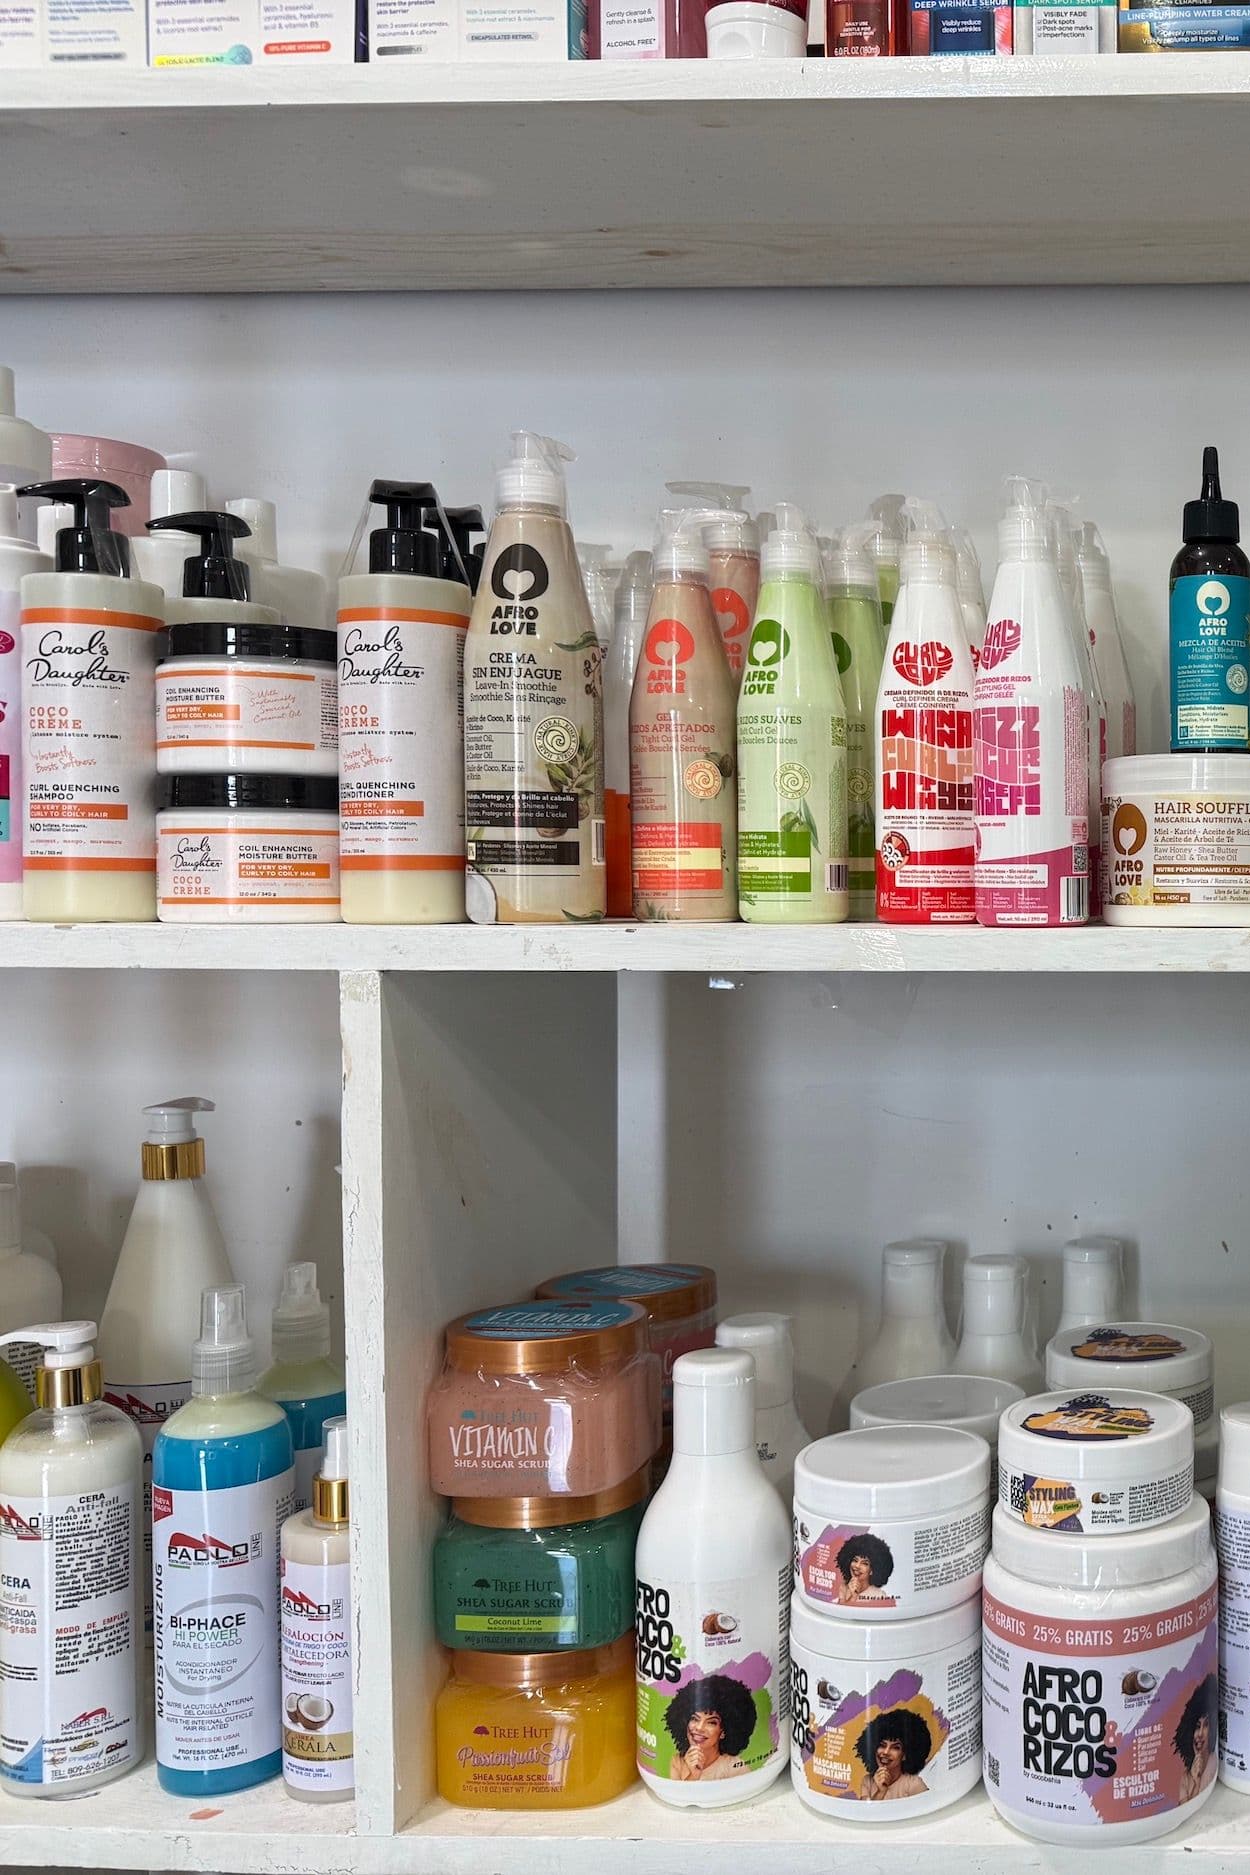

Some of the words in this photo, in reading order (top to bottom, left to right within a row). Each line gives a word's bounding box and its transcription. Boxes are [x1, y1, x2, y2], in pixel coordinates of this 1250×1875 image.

[941, 0, 977, 8] WRINKLE
[491, 605, 539, 621] AFRO
[490, 620, 537, 636] LOVE
[1198, 617, 1228, 627] AFRO
[1199, 627, 1227, 637] LOVE
[38, 630, 109, 657] Carol's
[344, 625, 404, 656] Carol's
[1179, 639, 1206, 649] MEZCLA
[1208, 639, 1219, 647] DE
[489, 652, 537, 665] CREMA
[26, 656, 128, 687] Daughter
[339, 652, 422, 685] Daughter
[472, 667, 489, 679] SIN
[744, 670, 778, 683] AFRO
[743, 683, 775, 696] LOVE
[29, 706, 69, 718] COCO
[30, 784, 50, 793] CURL
[52, 784, 120, 794] QUENCHING
[30, 793, 74, 801] SHAMPOO
[1154, 802, 1191, 816] HAIR
[1154, 816, 1201, 824] MASCARILLA
[1202, 816, 1243, 825] NUTRITIVA
[177, 836, 211, 854] Carol's
[238, 845, 259, 853] COIL
[262, 845, 313, 853] ENHANCING
[170, 853, 222, 871] Daughter
[239, 852, 283, 860] MOISTURE
[286, 853, 318, 861] BUTTER
[1114, 859, 1144, 873] AFRO
[1115, 873, 1142, 887] LOVE
[449, 1425, 538, 1460] VITAMIN
[454, 1459, 478, 1469] SHEA
[481, 1460, 515, 1469] SUGAR
[79, 1493, 106, 1506] CERA
[1028, 1486, 1076, 1502] STYLING
[1032, 1500, 1055, 1515] WAX
[168, 1543, 249, 1562] PAOLO
[1, 1574, 31, 1589] CERA
[492, 1579, 521, 1594] TREE
[523, 1578, 549, 1593] HUT
[457, 1597, 486, 1608] SHEA
[490, 1598, 531, 1609] SUGAR
[534, 1598, 574, 1609] SCRUB
[170, 1613, 246, 1631] BI-PHACE
[487, 1617, 520, 1627] Coconut
[522, 1617, 542, 1627] Lime
[995, 1611, 1026, 1637] GRATIS
[1033, 1624, 1062, 1646] 25%
[1065, 1630, 1113, 1647] GRATIS
[1124, 1624, 1153, 1646] 25%
[1156, 1612, 1194, 1638] GRATIS
[155, 1564, 165, 1718] MOISTURIZING
[175, 1631, 186, 1641] HI
[188, 1628, 239, 1643] POWER
[1022, 1661, 1103, 1705] AFRO
[1022, 1696, 1107, 1745] COCO
[491, 1726, 520, 1739] TREE
[522, 1725, 550, 1738] HUT
[457, 1743, 539, 1769] Passionfruit
[540, 1742, 571, 1767] Sol
[1023, 1734, 1118, 1780] RIZOS
[472, 1773, 494, 1781] SHEA
[495, 1774, 524, 1782] SUGAR
[526, 1774, 553, 1783] SCRUB
[1113, 1770, 1160, 1789] ESCULTOR
[1113, 1787, 1127, 1801] DE
[1128, 1781, 1155, 1799] RIZOS
